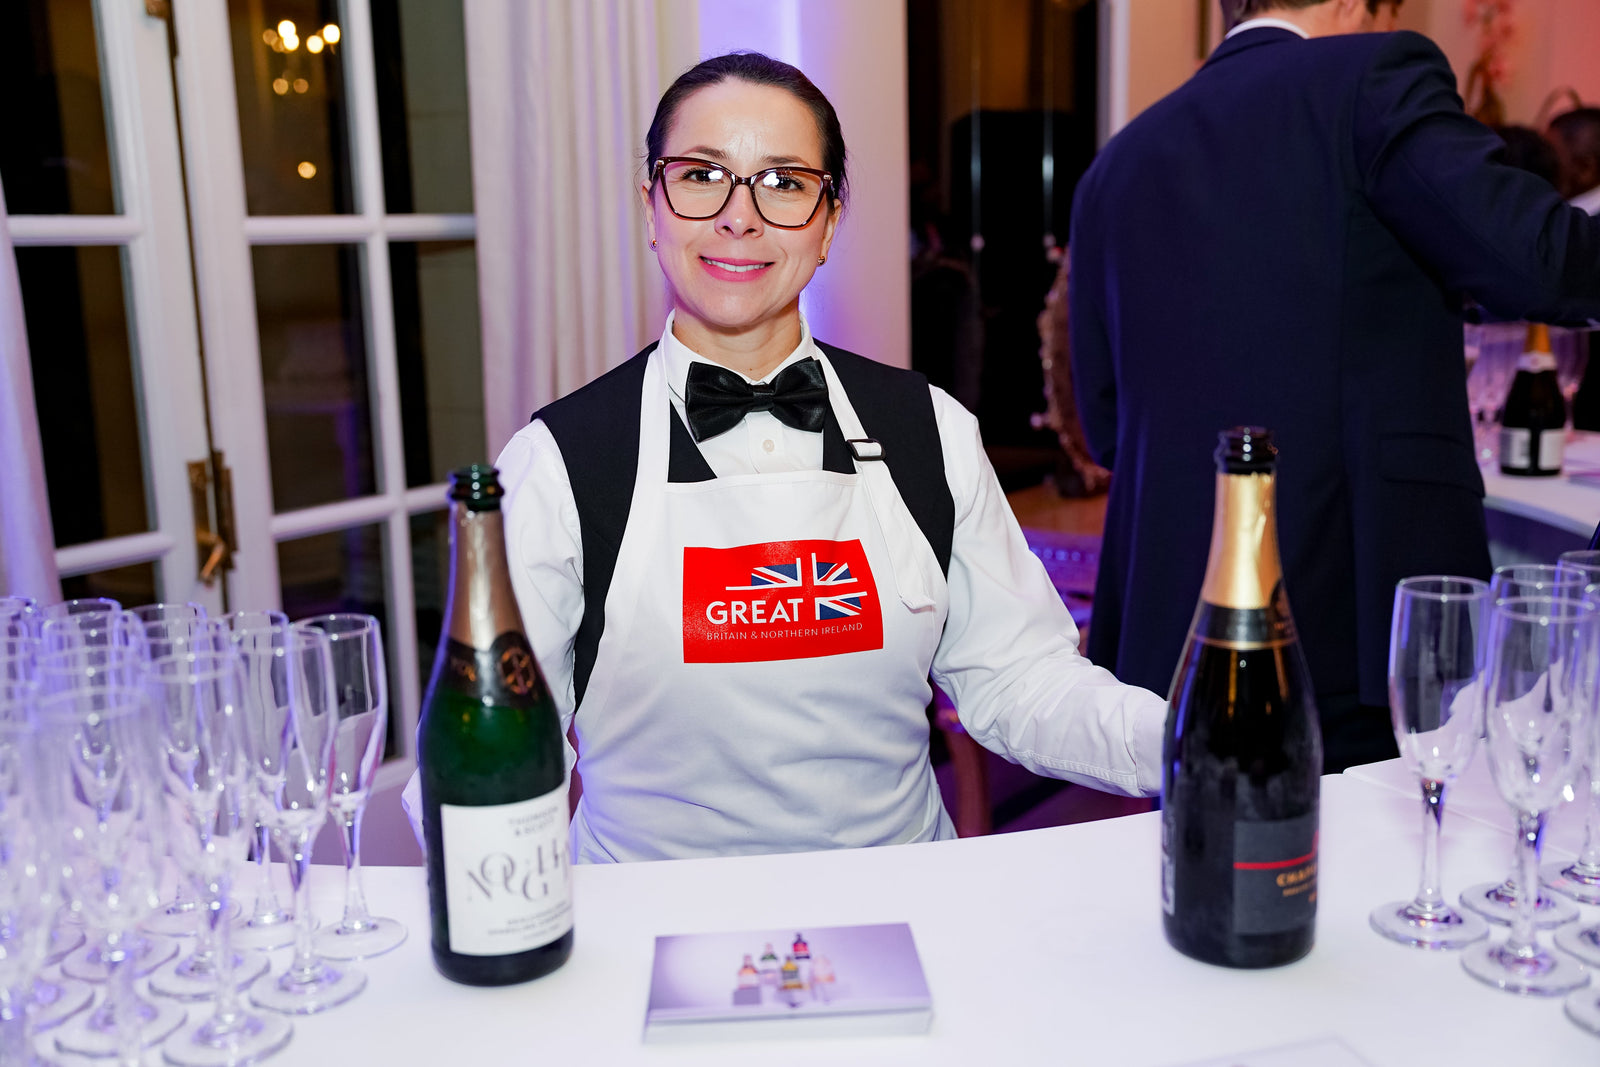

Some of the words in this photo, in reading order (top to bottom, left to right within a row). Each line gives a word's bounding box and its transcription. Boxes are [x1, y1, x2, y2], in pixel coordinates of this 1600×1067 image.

[705, 598, 803, 625] GREAT
[706, 631, 748, 641] BRITAIN
[750, 630, 759, 640] &
[760, 628, 819, 640] NORTHERN
[821, 623, 863, 635] IRELAND
